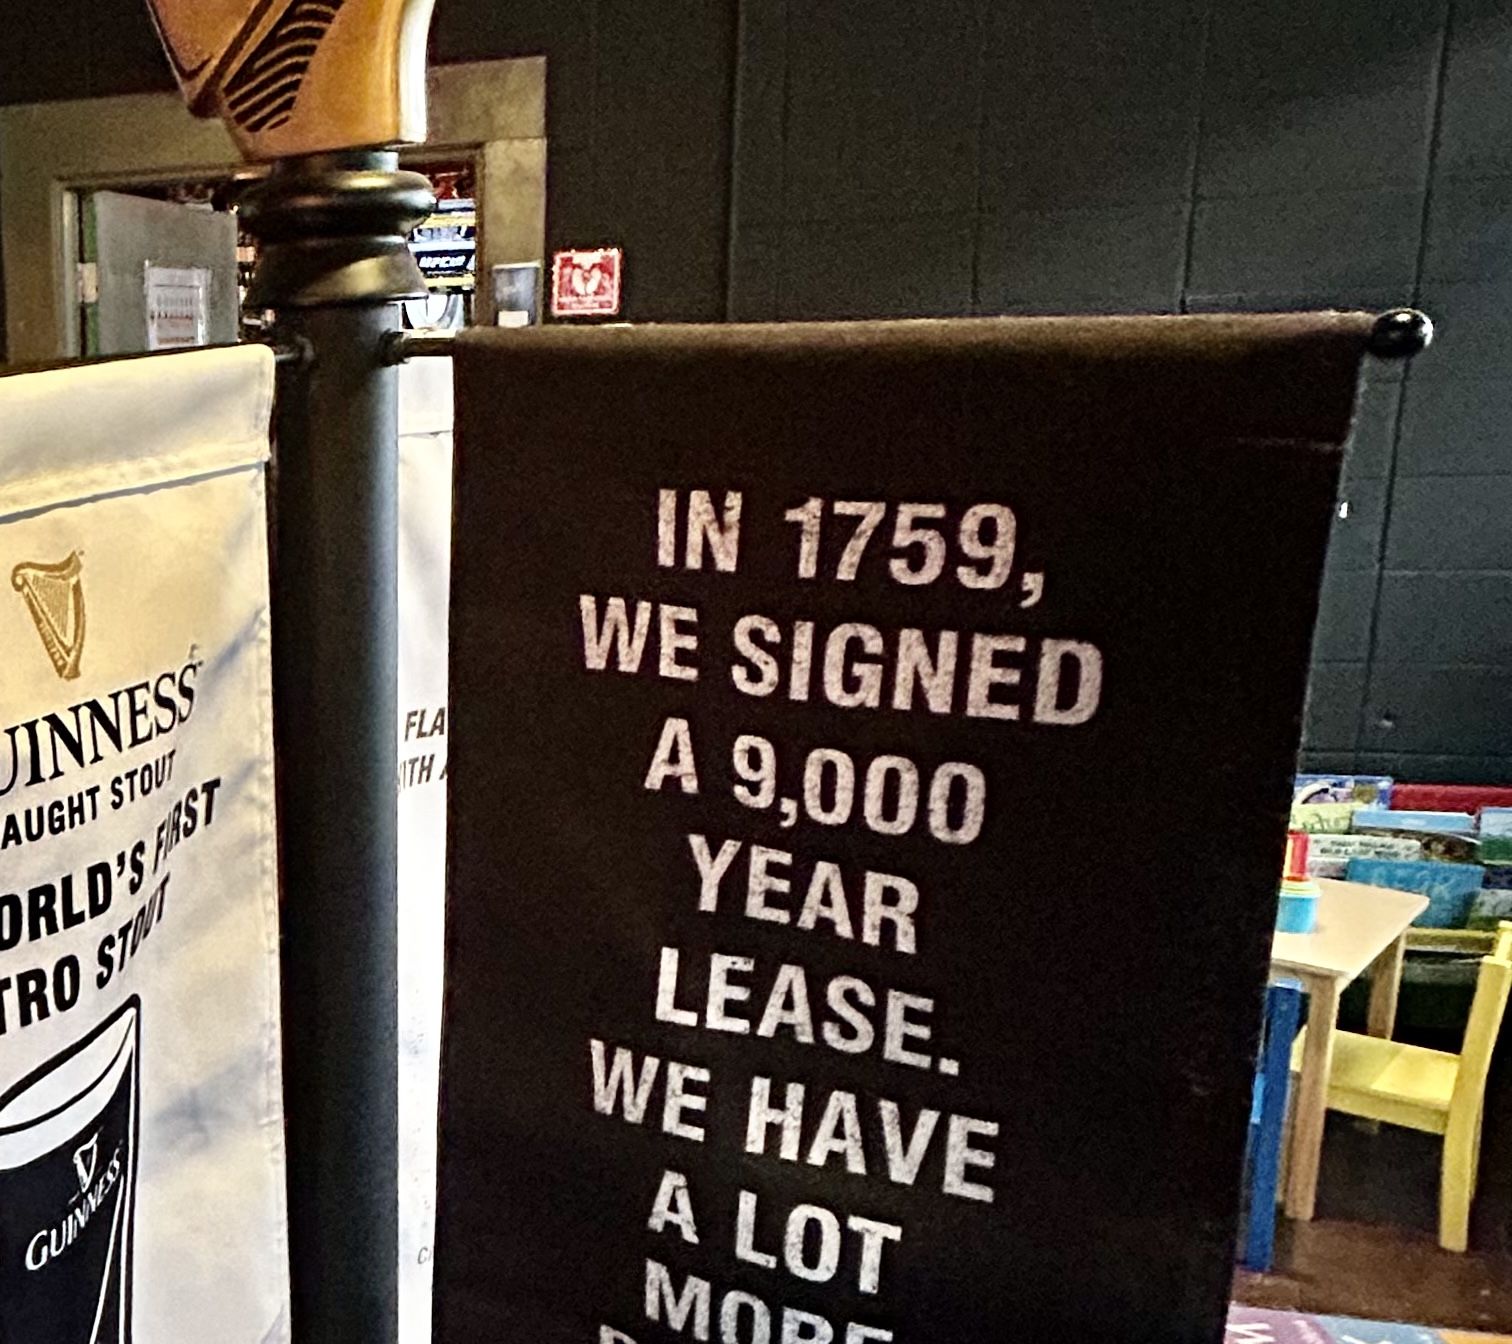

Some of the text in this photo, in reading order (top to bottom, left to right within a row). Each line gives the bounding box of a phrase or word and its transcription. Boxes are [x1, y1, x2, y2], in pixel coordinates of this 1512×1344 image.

[656, 488, 1045, 609] IN 1759,
[579, 594, 1104, 726] WE SIGNED
[110, 749, 177, 811] STOUT
[404, 706, 446, 742] FLA
[644, 717, 987, 846] A 9,000
[152, 777, 222, 875] FIRST
[96, 873, 171, 988] STOUT
[688, 833, 920, 954] YEAR
[655, 946, 960, 1076] LEASE.
[589, 1038, 1000, 1203] WE HAVE
[647, 1169, 903, 1294] A LOT
